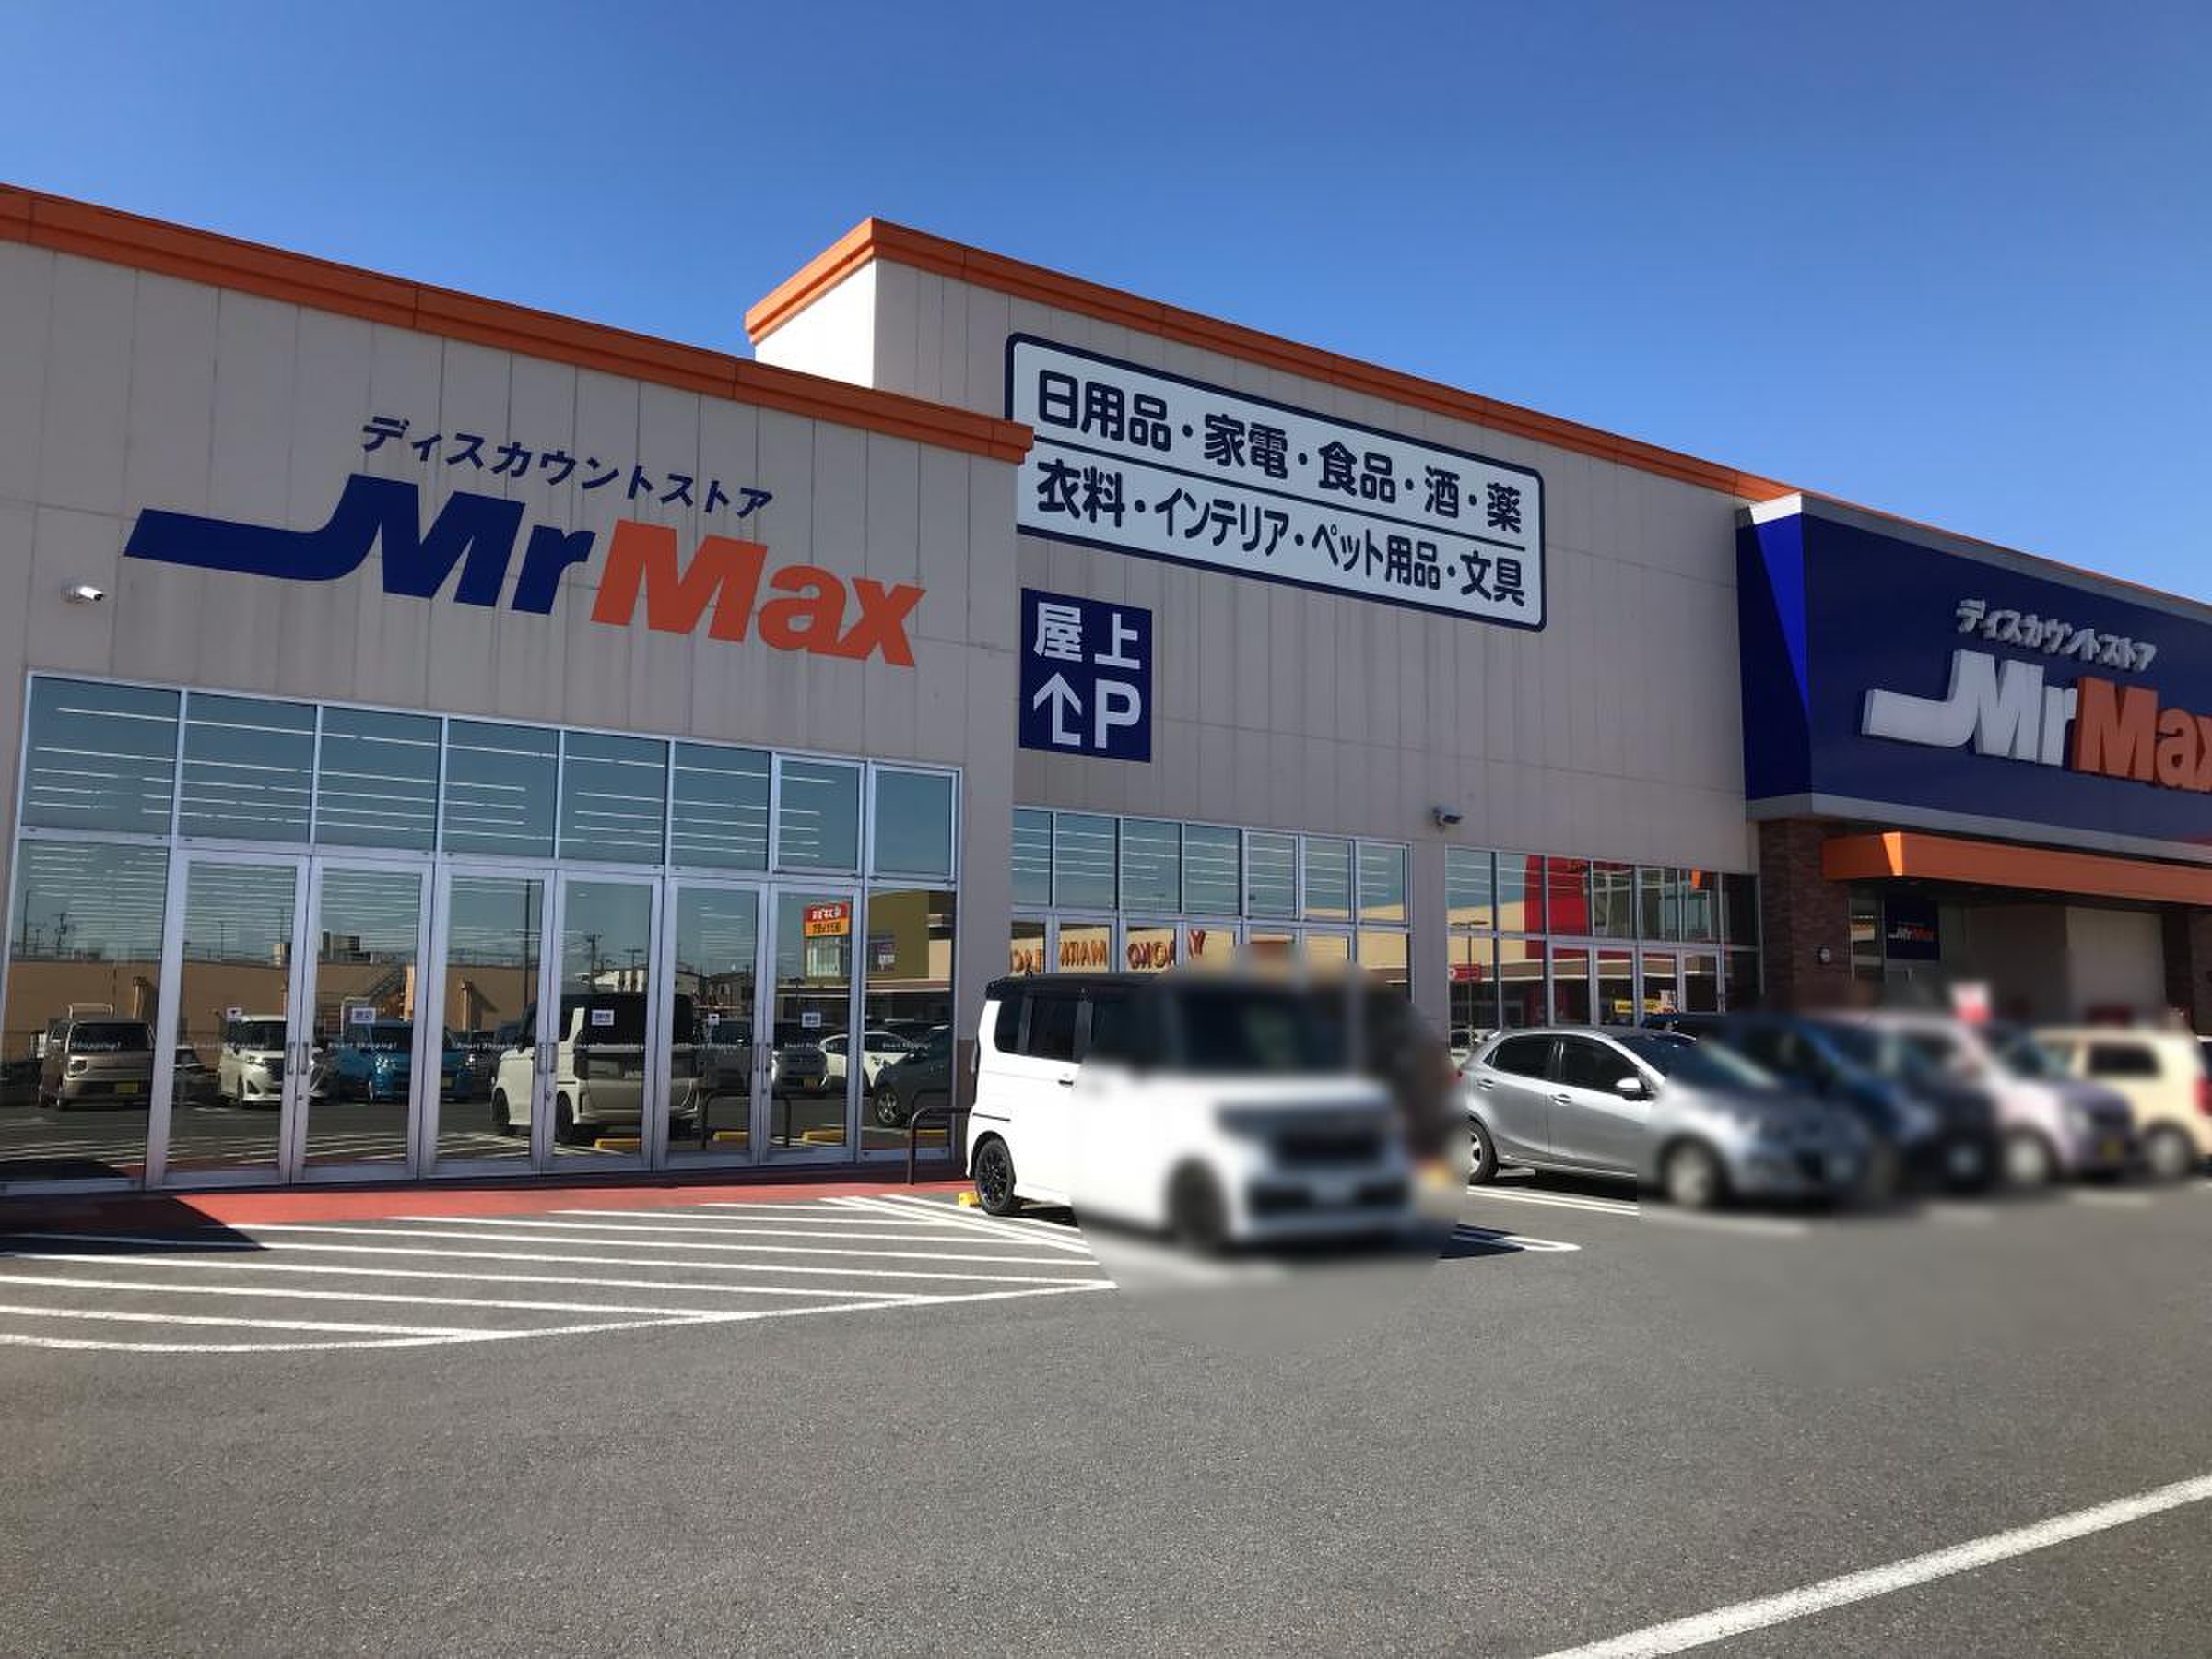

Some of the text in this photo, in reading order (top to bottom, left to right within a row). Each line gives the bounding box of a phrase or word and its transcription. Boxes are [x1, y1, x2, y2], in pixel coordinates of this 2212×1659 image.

[362, 416, 772, 518] ディスカウントストア
[1033, 602, 1141, 670] 屋上
[1094, 678, 1141, 749] P
